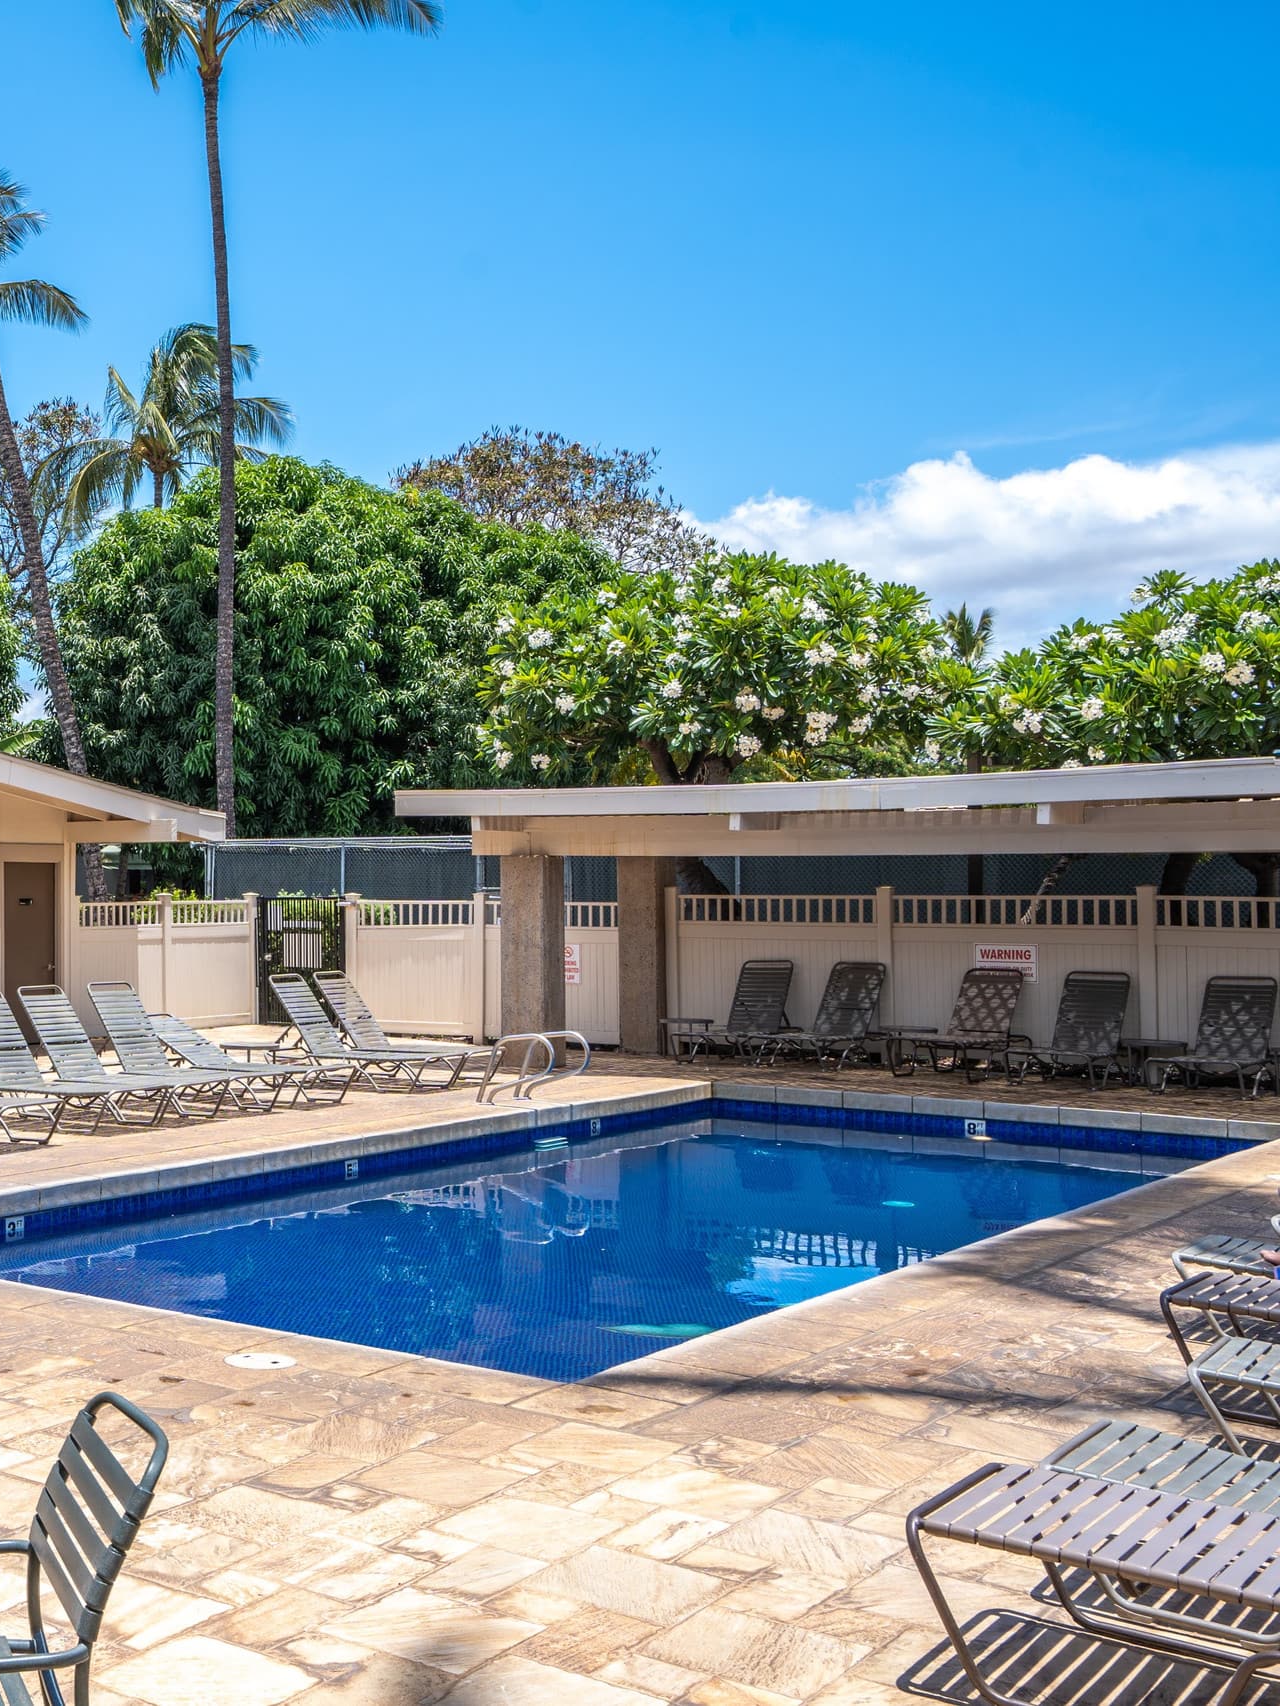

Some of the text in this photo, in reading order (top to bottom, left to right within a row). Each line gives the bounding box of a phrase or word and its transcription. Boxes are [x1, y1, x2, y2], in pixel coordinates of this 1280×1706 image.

[979, 948, 1032, 961] WARNING
[967, 1122, 977, 1136] 8
[7, 1221, 16, 1238] 3
